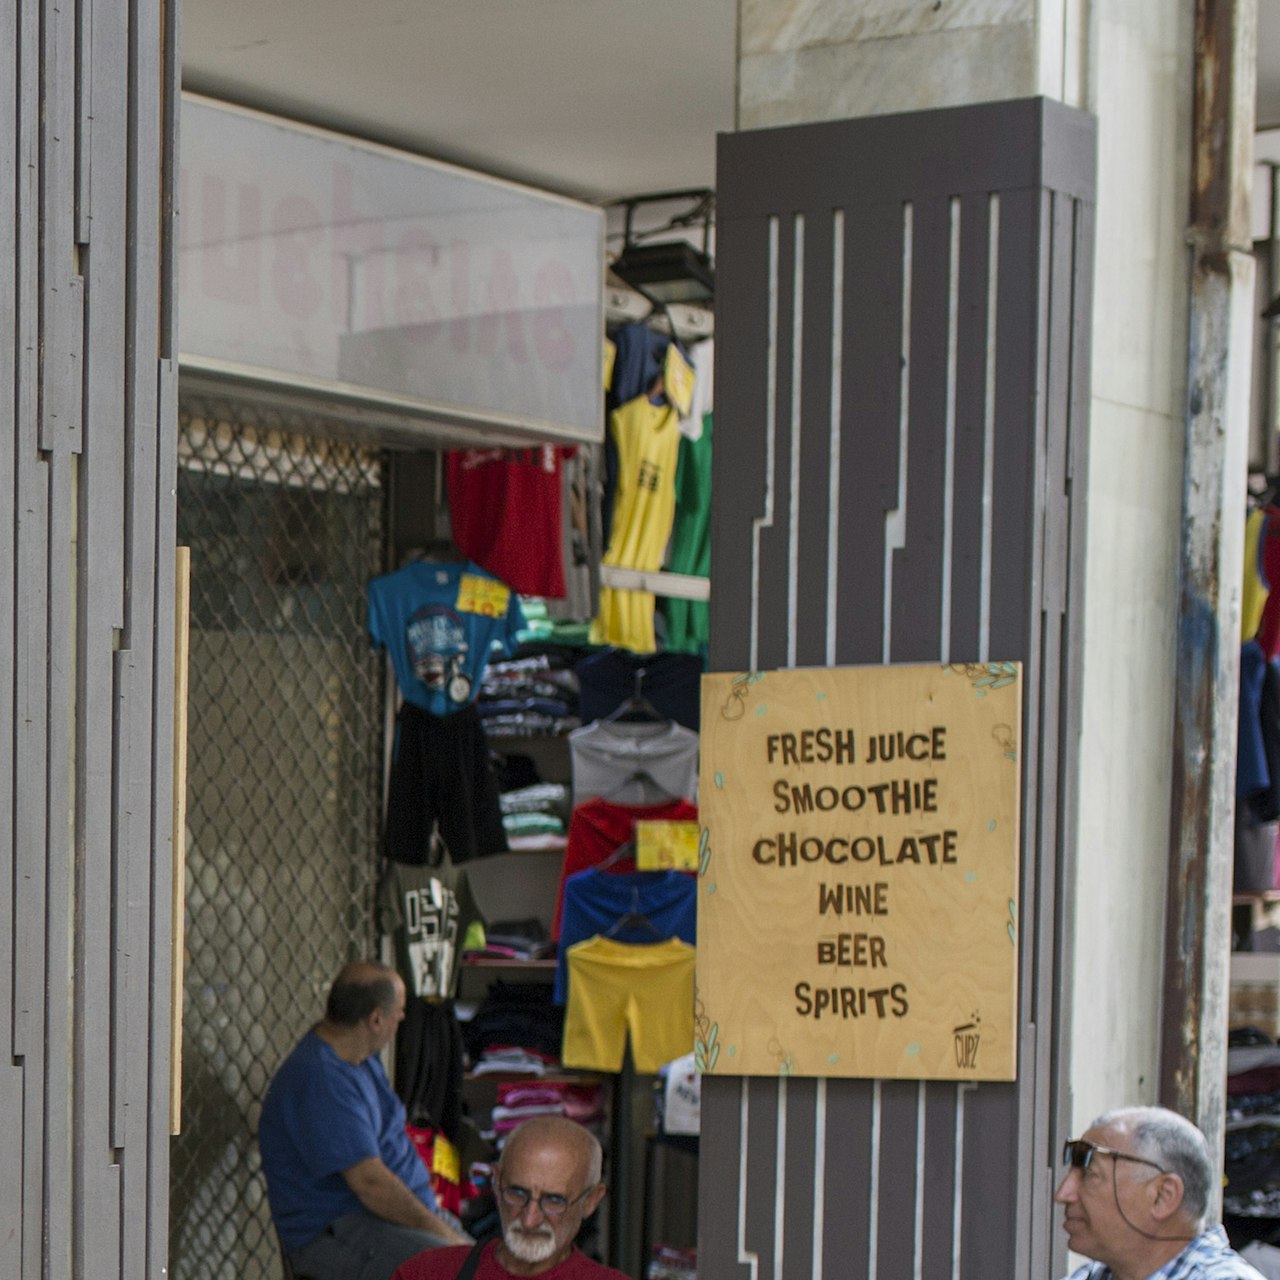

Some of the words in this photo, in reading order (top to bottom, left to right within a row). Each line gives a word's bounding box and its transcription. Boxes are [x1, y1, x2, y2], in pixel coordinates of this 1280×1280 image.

[766, 727, 855, 765] FRESH
[865, 726, 947, 764] JUICE
[773, 778, 938, 816] SMOOTHIE
[752, 829, 958, 867] CHOCOLATE
[819, 882, 888, 916] WINE
[817, 933, 887, 968] BEER
[794, 982, 909, 1019] SPIRITS
